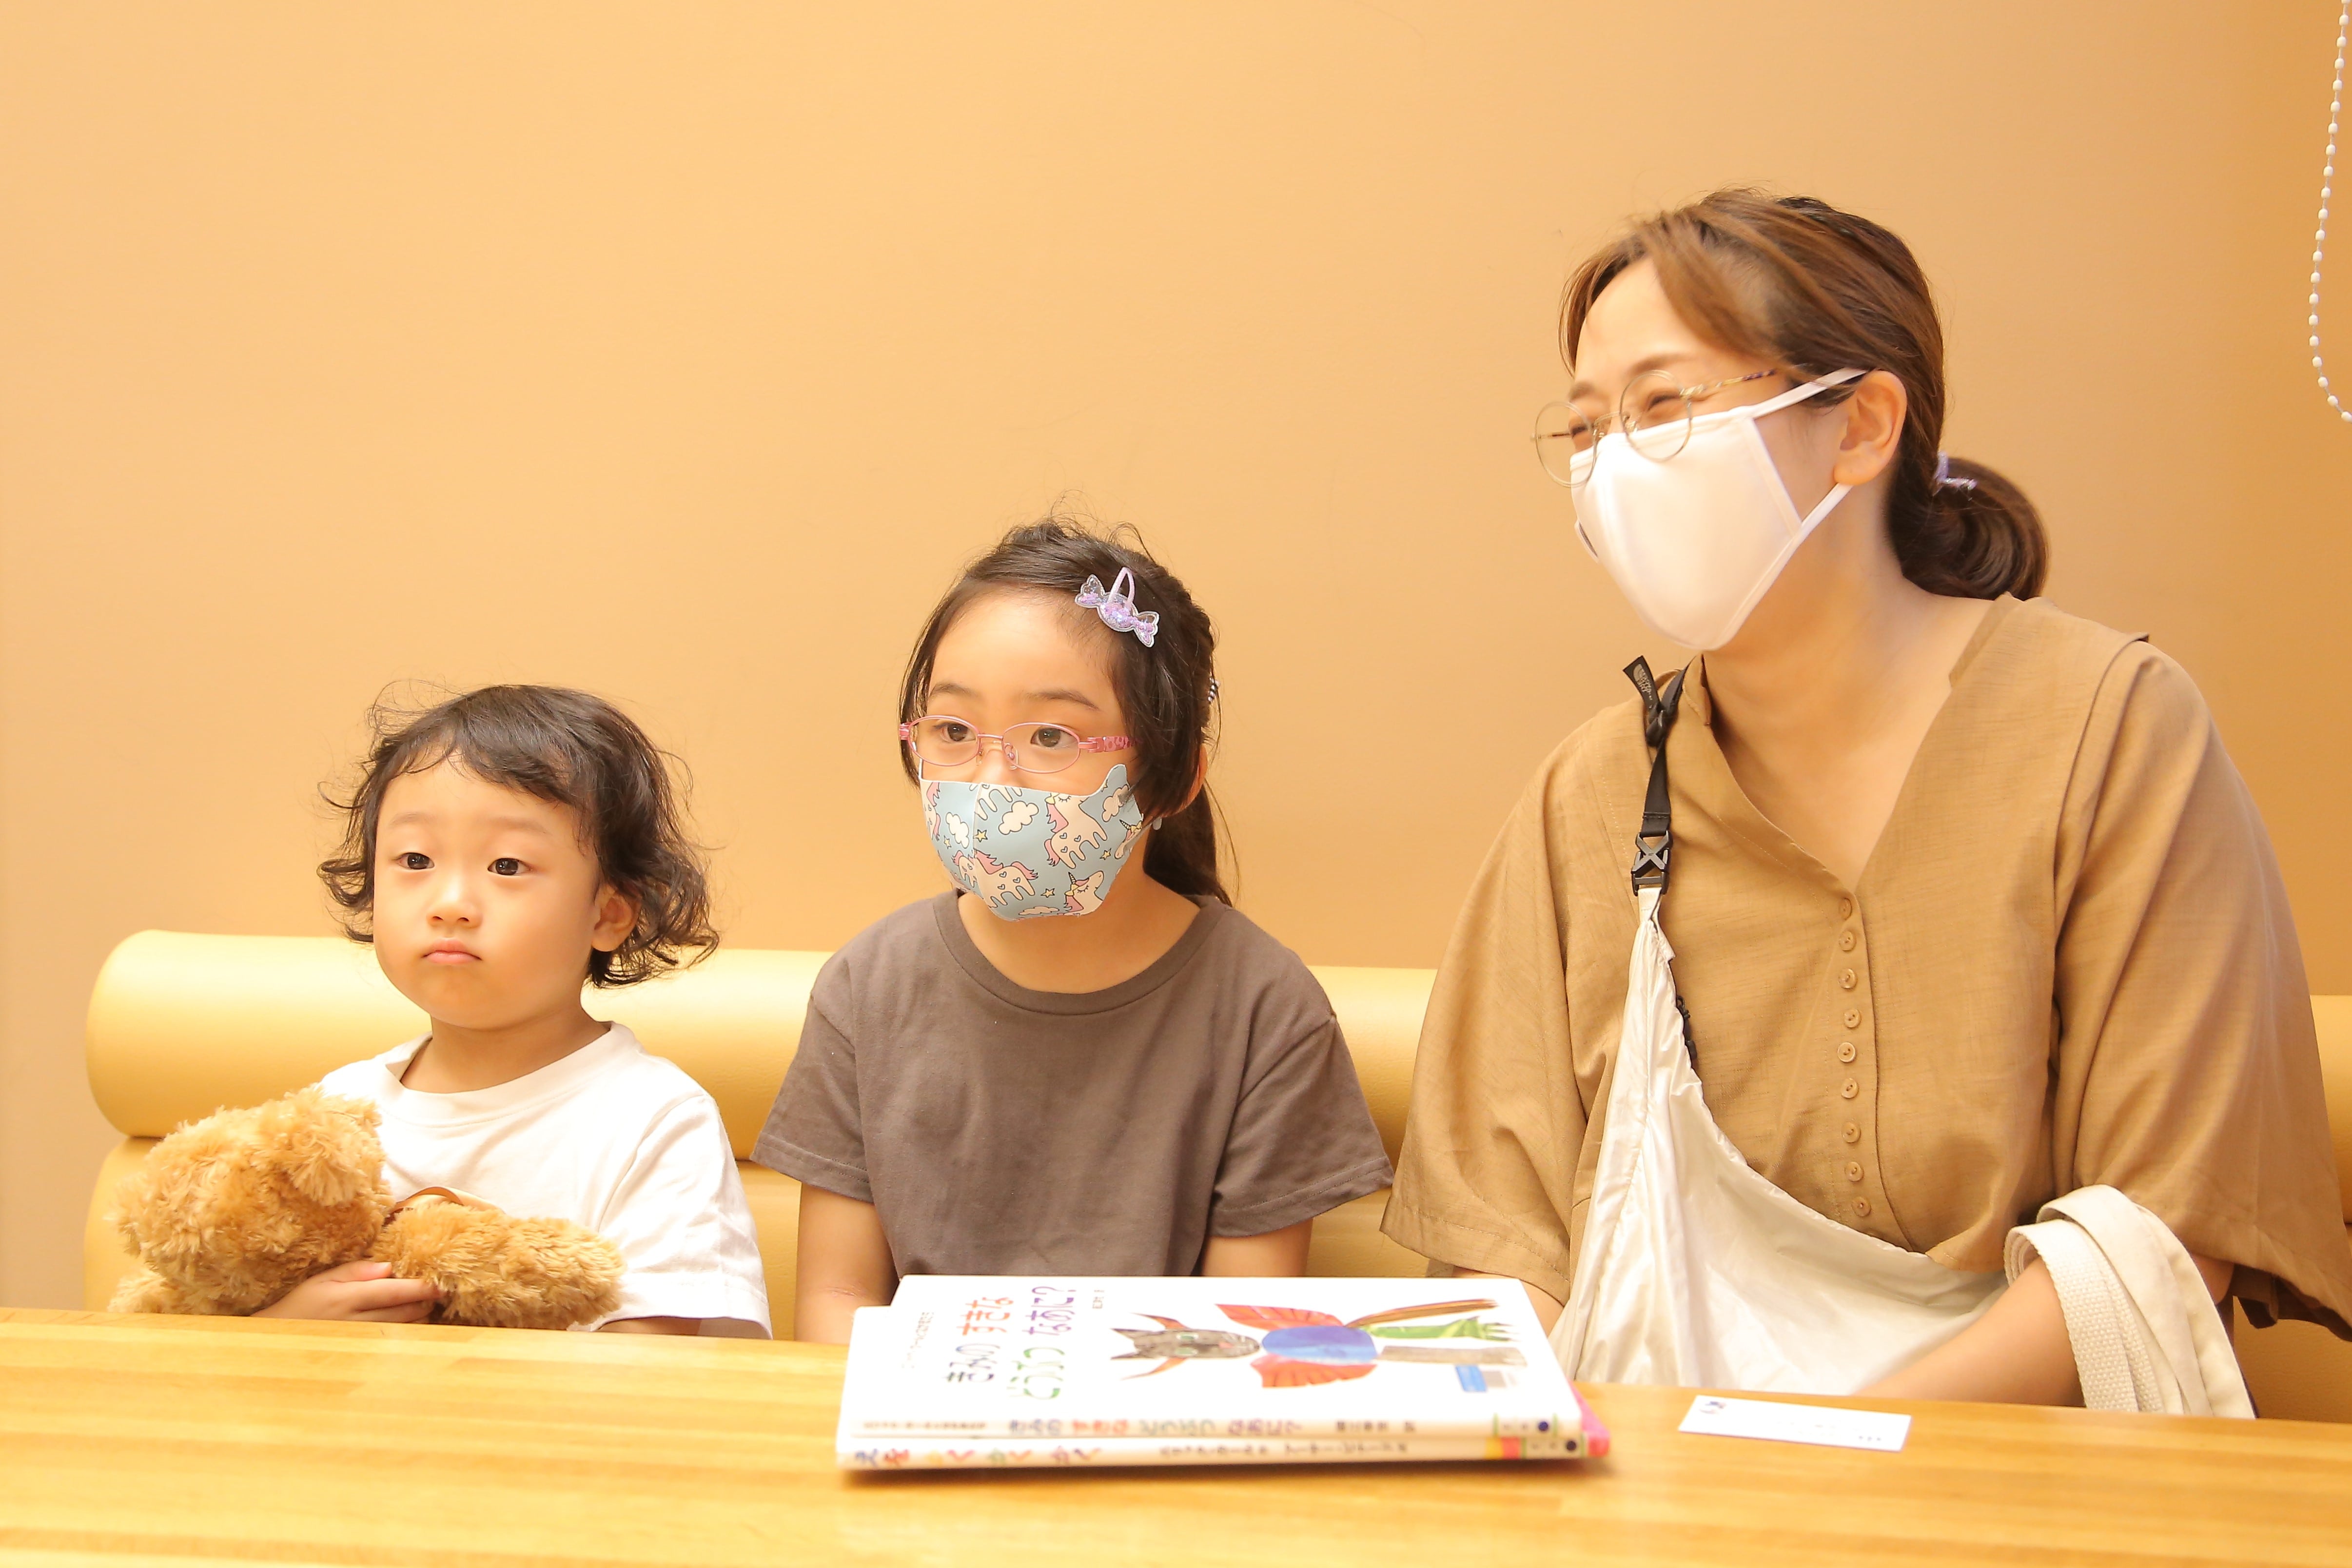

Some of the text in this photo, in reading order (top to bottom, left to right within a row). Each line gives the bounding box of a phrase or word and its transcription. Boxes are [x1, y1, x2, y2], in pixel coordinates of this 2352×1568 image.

[943, 1297, 1014, 1383] きみの すきな
[1007, 1347, 1065, 1400] どうぶつ
